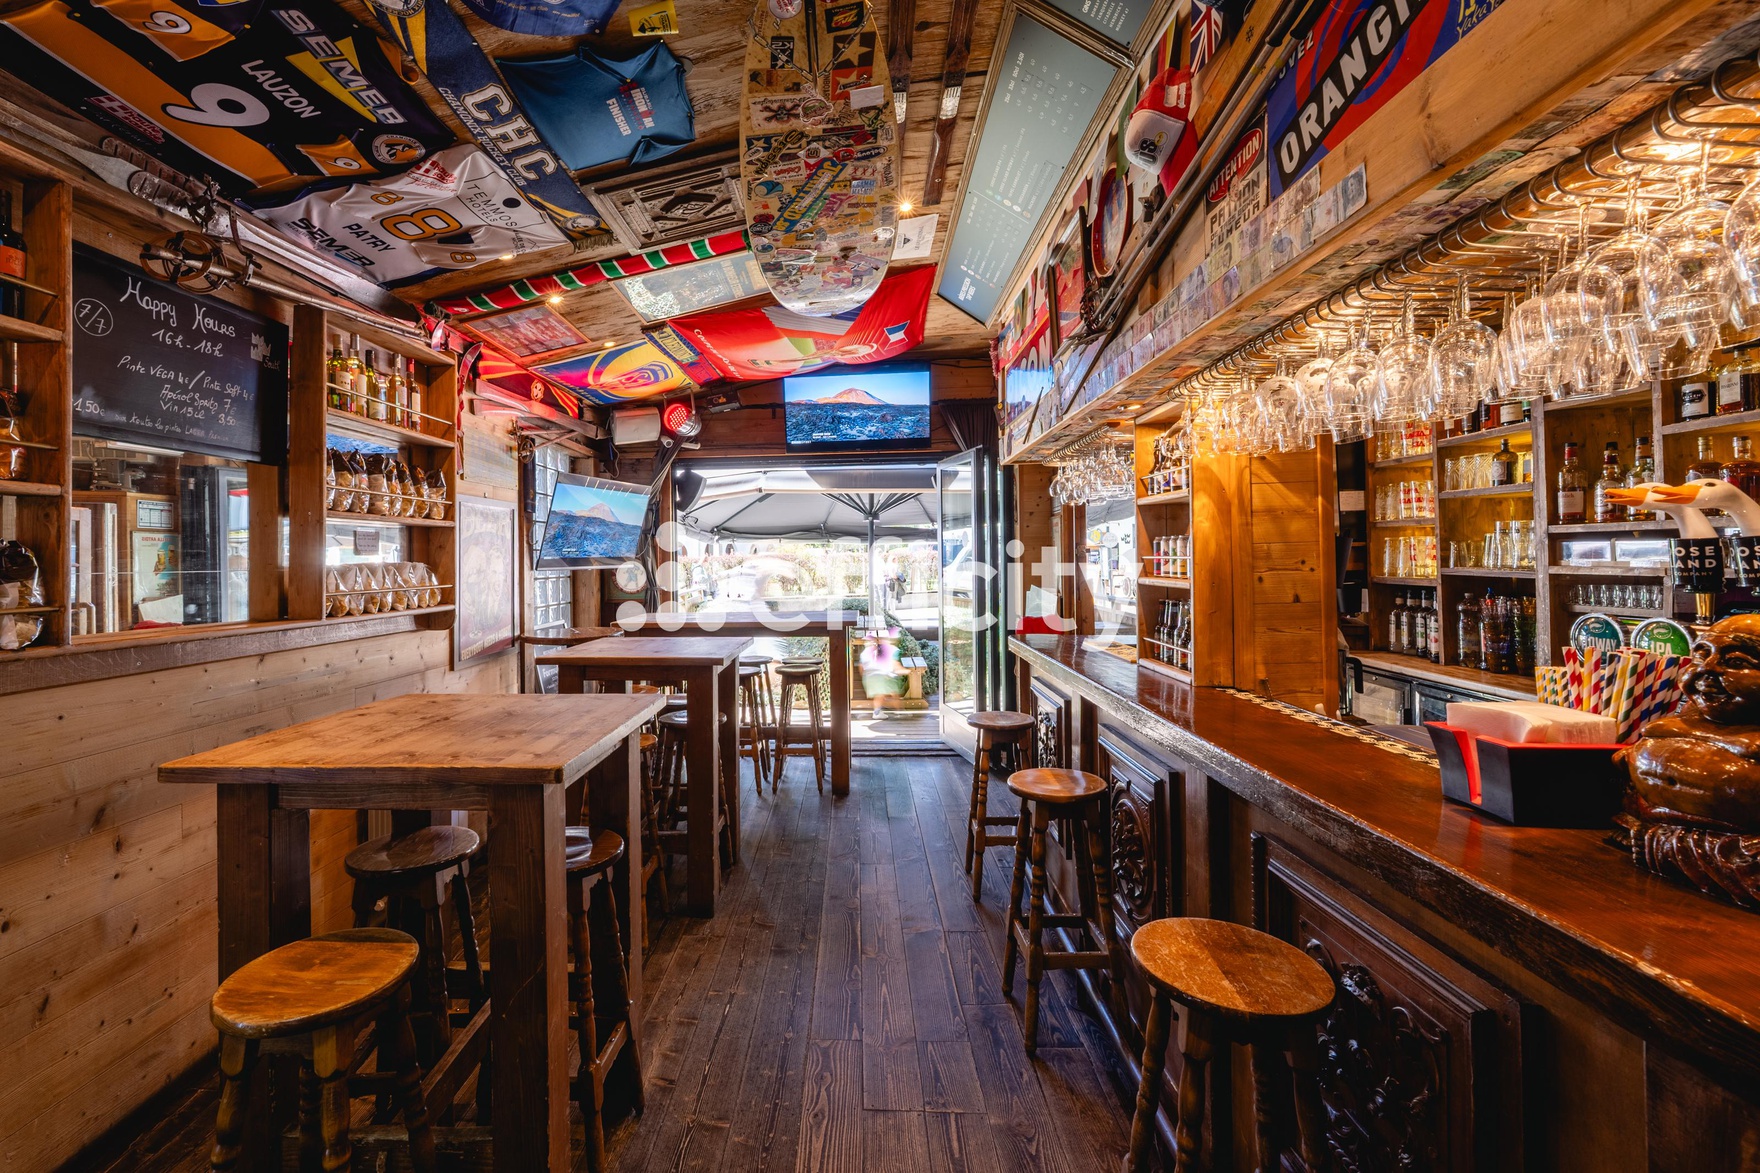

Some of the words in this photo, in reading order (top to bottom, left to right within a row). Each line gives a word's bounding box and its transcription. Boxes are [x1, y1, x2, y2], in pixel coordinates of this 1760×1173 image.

[1102, 2, 1115, 24] CITADELLE
[1115, 13, 1126, 31] MONKEY
[1457, 4, 1487, 40] Yaka
[771, 41, 794, 49] K2
[271, 9, 408, 125] SEMER
[1011, 64, 1020, 78] 50cl
[162, 82, 270, 128] 9
[240, 59, 321, 118] LAUZON
[460, 83, 558, 182] CHC
[606, 98, 631, 136] FINISHER
[438, 87, 480, 141] CHAMONIX
[479, 134, 513, 171] HOCKEY
[506, 166, 527, 187] CLUB
[1209, 133, 1259, 198] ATTENTION
[371, 192, 404, 205] 8
[467, 197, 499, 223] HOTELS
[472, 183, 518, 227] TEMMOS
[1238, 191, 1260, 214] BONNE
[342, 223, 398, 253] PATRY
[380, 207, 463, 241] 8
[291, 218, 376, 266] SEMER
[450, 251, 477, 263] 8
[76, 302, 107, 334] 7/7
[120, 276, 177, 327] Happy
[192, 303, 236, 337] Hours
[152, 329, 183, 348] 16h
[193, 340, 223, 358] 18h
[117, 355, 145, 374] Pinte
[150, 364, 175, 380] VEGA
[203, 377, 222, 392] Pinte
[160, 400, 178, 413] Vin
[1651, 641, 1673, 656] IPA
